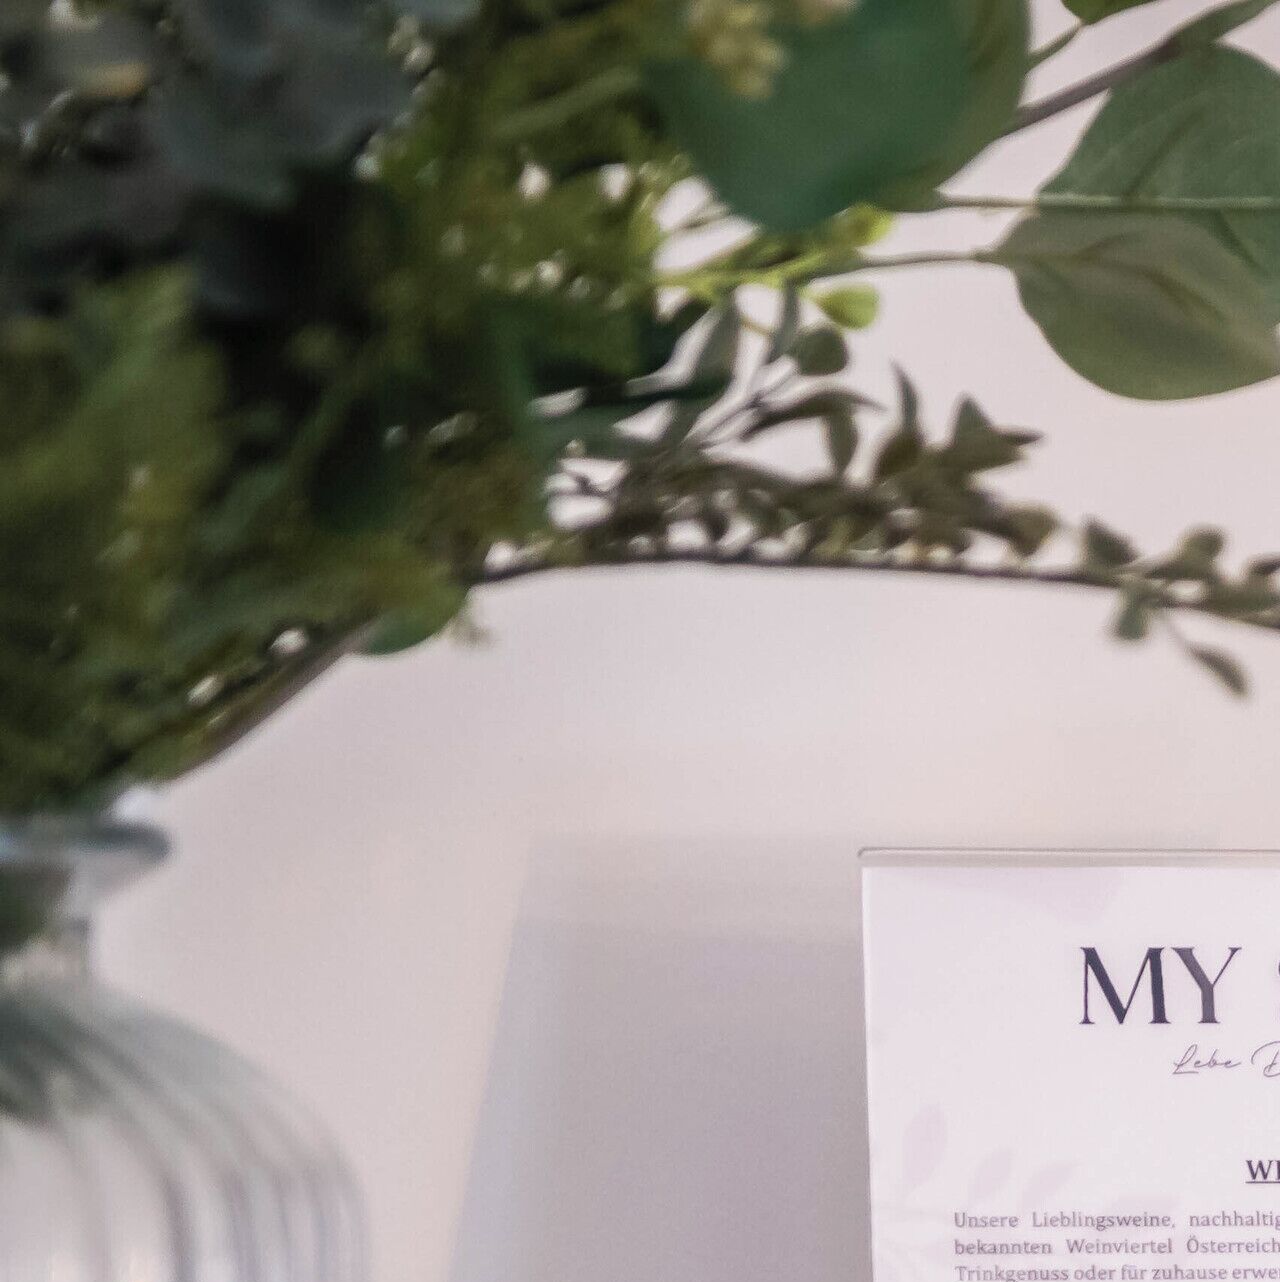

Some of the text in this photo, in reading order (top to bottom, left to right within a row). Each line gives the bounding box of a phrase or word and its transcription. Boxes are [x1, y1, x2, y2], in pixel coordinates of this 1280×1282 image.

[1079, 946, 1242, 1026] MY
[1171, 1044, 1242, 1076] Lebe
[953, 1212, 1018, 1228] Unsere
[1032, 1211, 1174, 1231] Lieblingsweine,
[953, 1239, 1052, 1255] bekannten
[1066, 1238, 1173, 1254] Weinviertel
[1073, 1265, 1116, 1281] oder
[1120, 1264, 1146, 1280] für
[1151, 1266, 1227, 1280] zuhause
